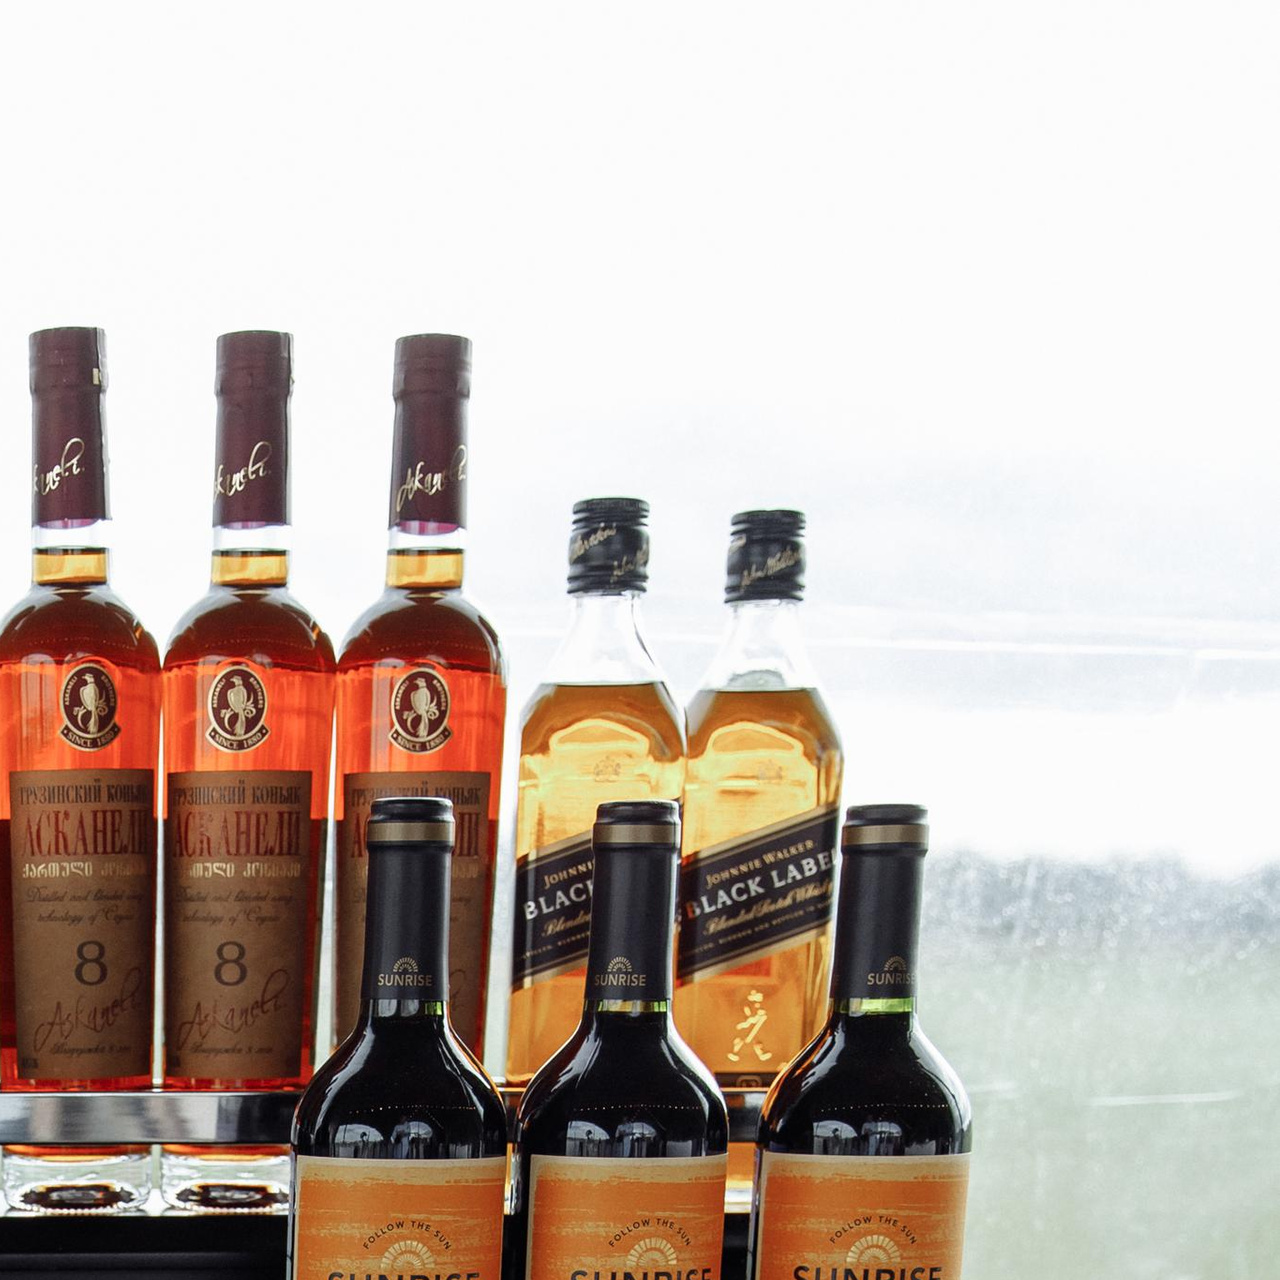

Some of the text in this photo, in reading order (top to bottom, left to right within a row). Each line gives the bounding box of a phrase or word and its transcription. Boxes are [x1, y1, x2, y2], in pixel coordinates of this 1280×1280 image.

[67, 732, 93, 748] SINCE
[214, 734, 238, 749] SINCE
[398, 735, 421, 750] SINCE
[20, 778, 101, 805] ГРУЗИНСКИЙ
[252, 786, 300, 804] КОНЬЯК
[173, 811, 300, 856] АСКАНЕЛИ
[763, 840, 814, 864] WALKER
[687, 876, 765, 918] BLACK
[74, 940, 108, 985] 8
[214, 941, 247, 986] 8
[378, 974, 432, 986] SUNRISE
[594, 974, 646, 986] SUNRISE
[363, 1221, 451, 1250] FOLLOW THE SUN
[609, 1218, 691, 1247] FOLLOW THE SUN
[829, 1216, 917, 1244] FOLLOW THE SUN
